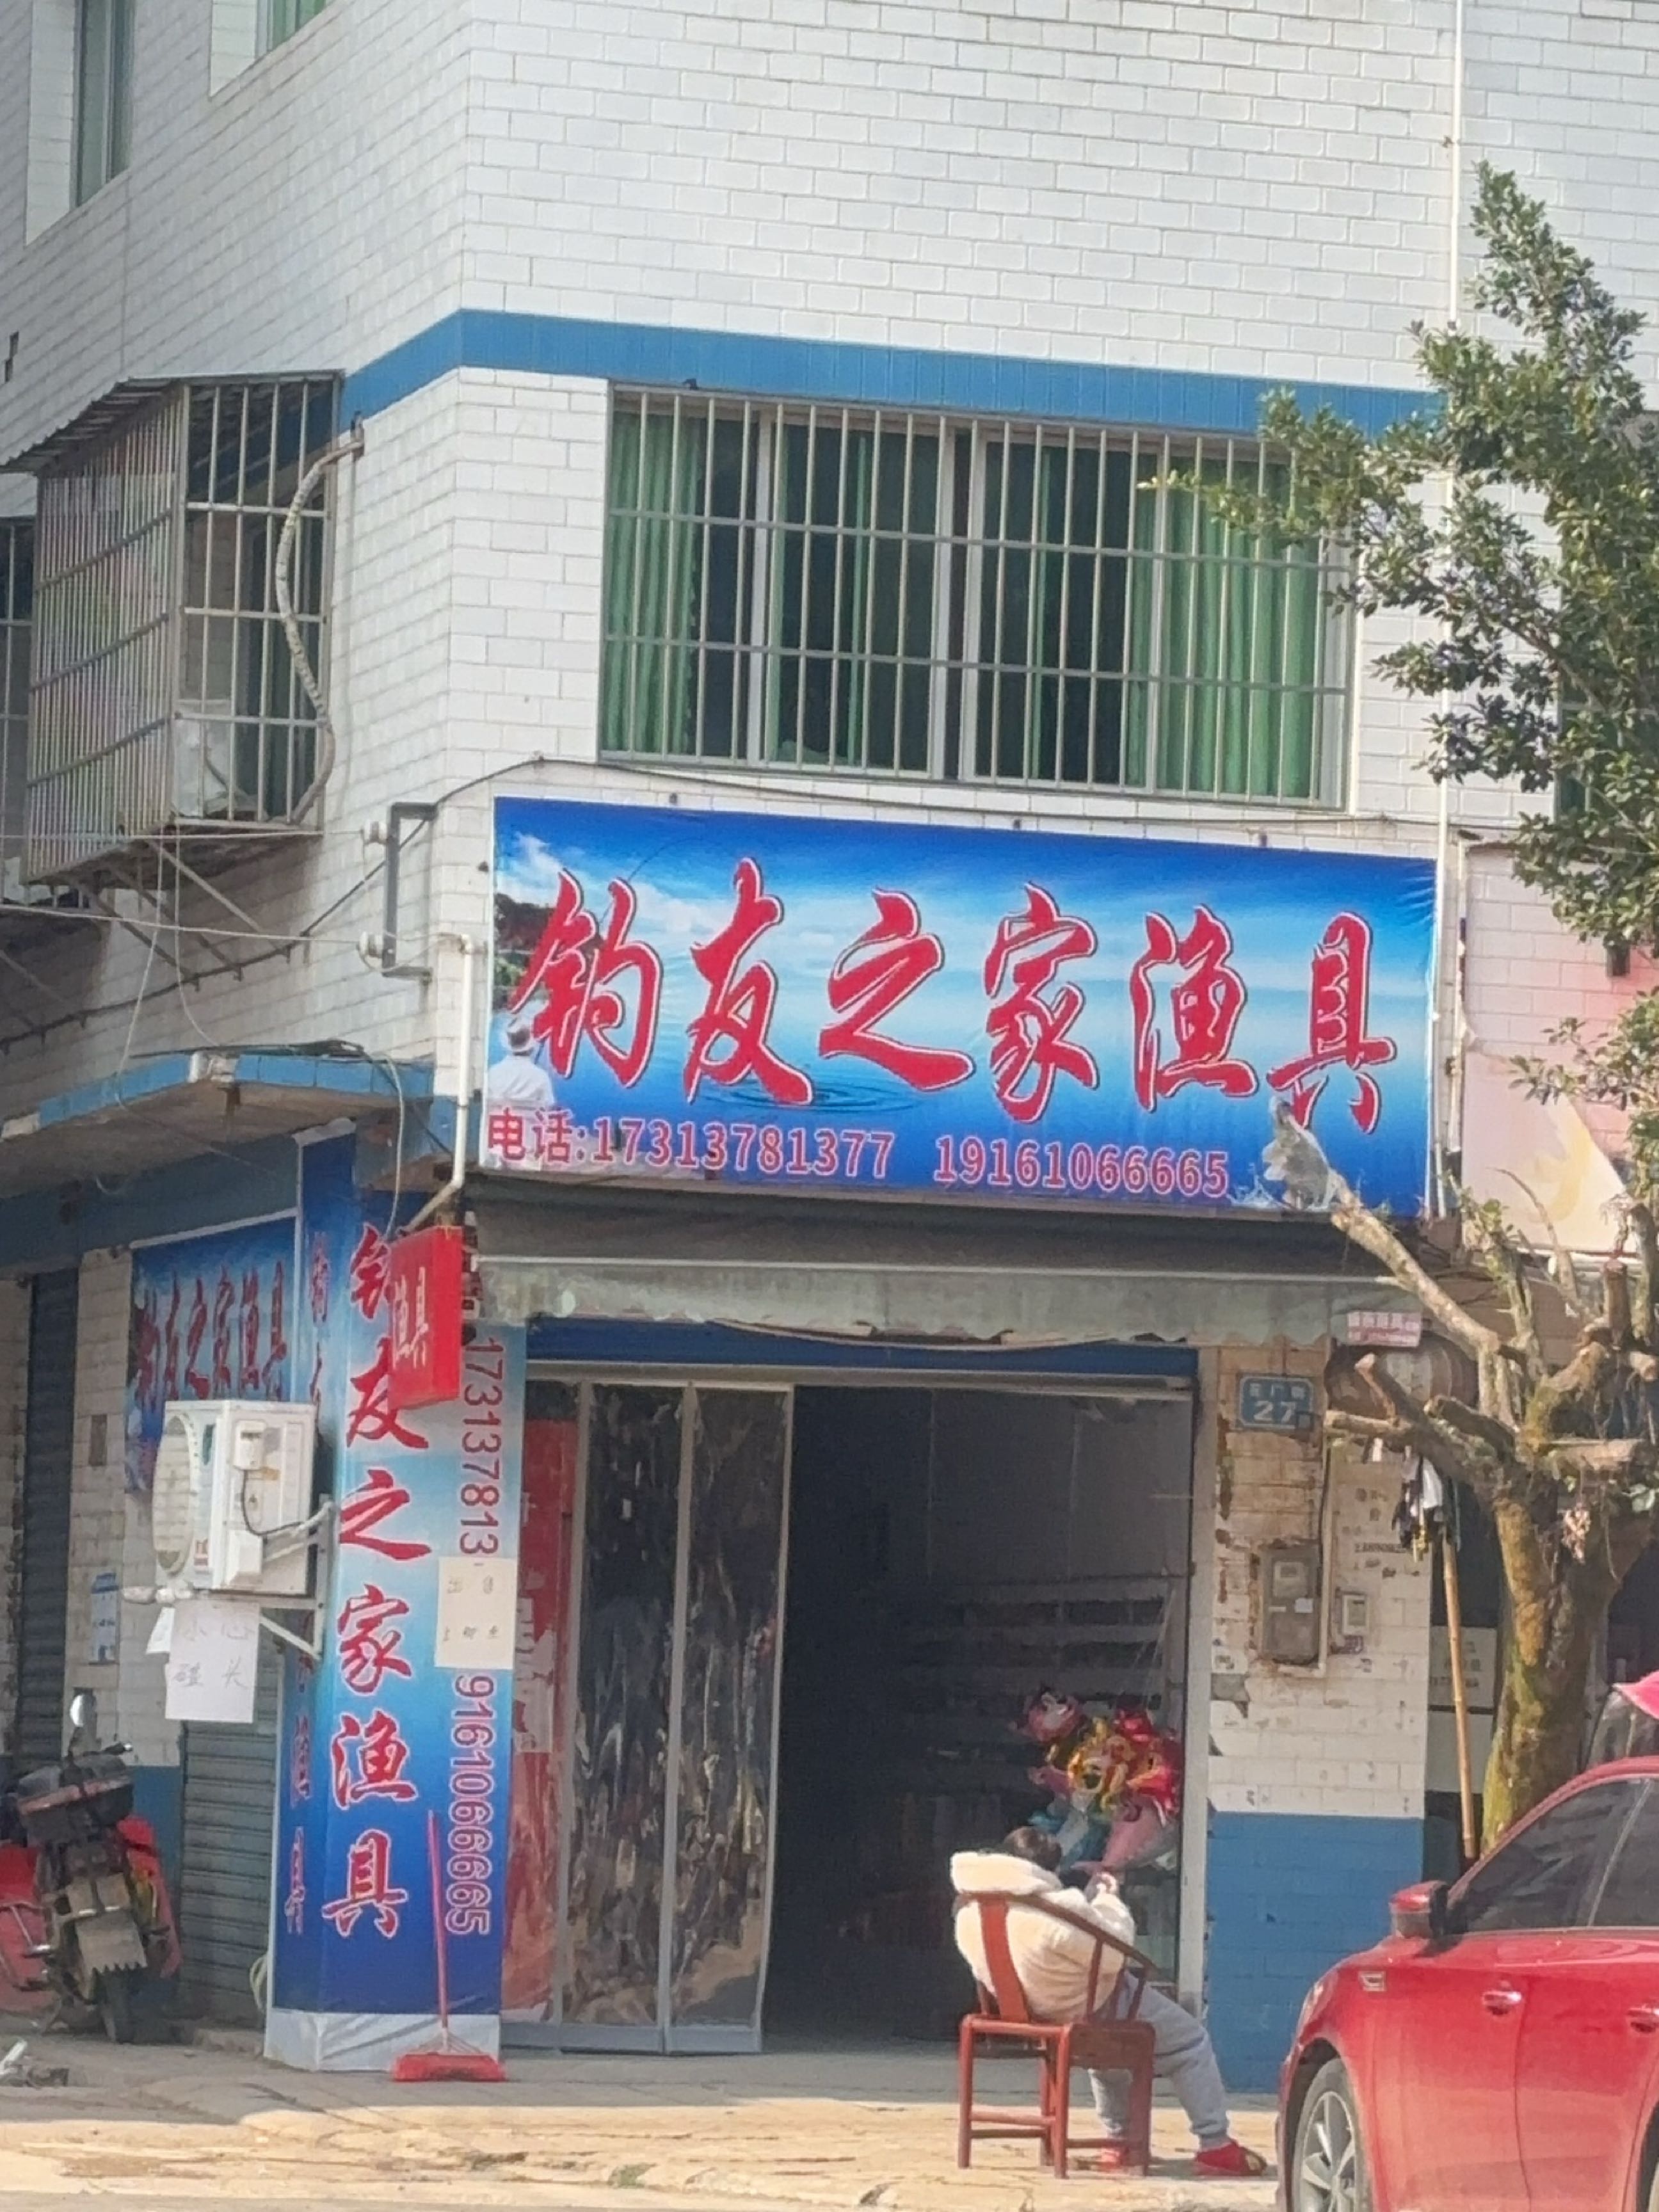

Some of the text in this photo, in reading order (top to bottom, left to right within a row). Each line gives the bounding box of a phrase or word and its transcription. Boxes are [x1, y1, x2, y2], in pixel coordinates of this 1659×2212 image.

[511, 856, 1395, 1135] 钓友之家渔具
[933, 1135, 1230, 1200] 19161066665
[459, 1336, 505, 1554] 173137813
[1253, 1400, 1297, 1423] 27
[444, 1676, 497, 1936] 9161066665
